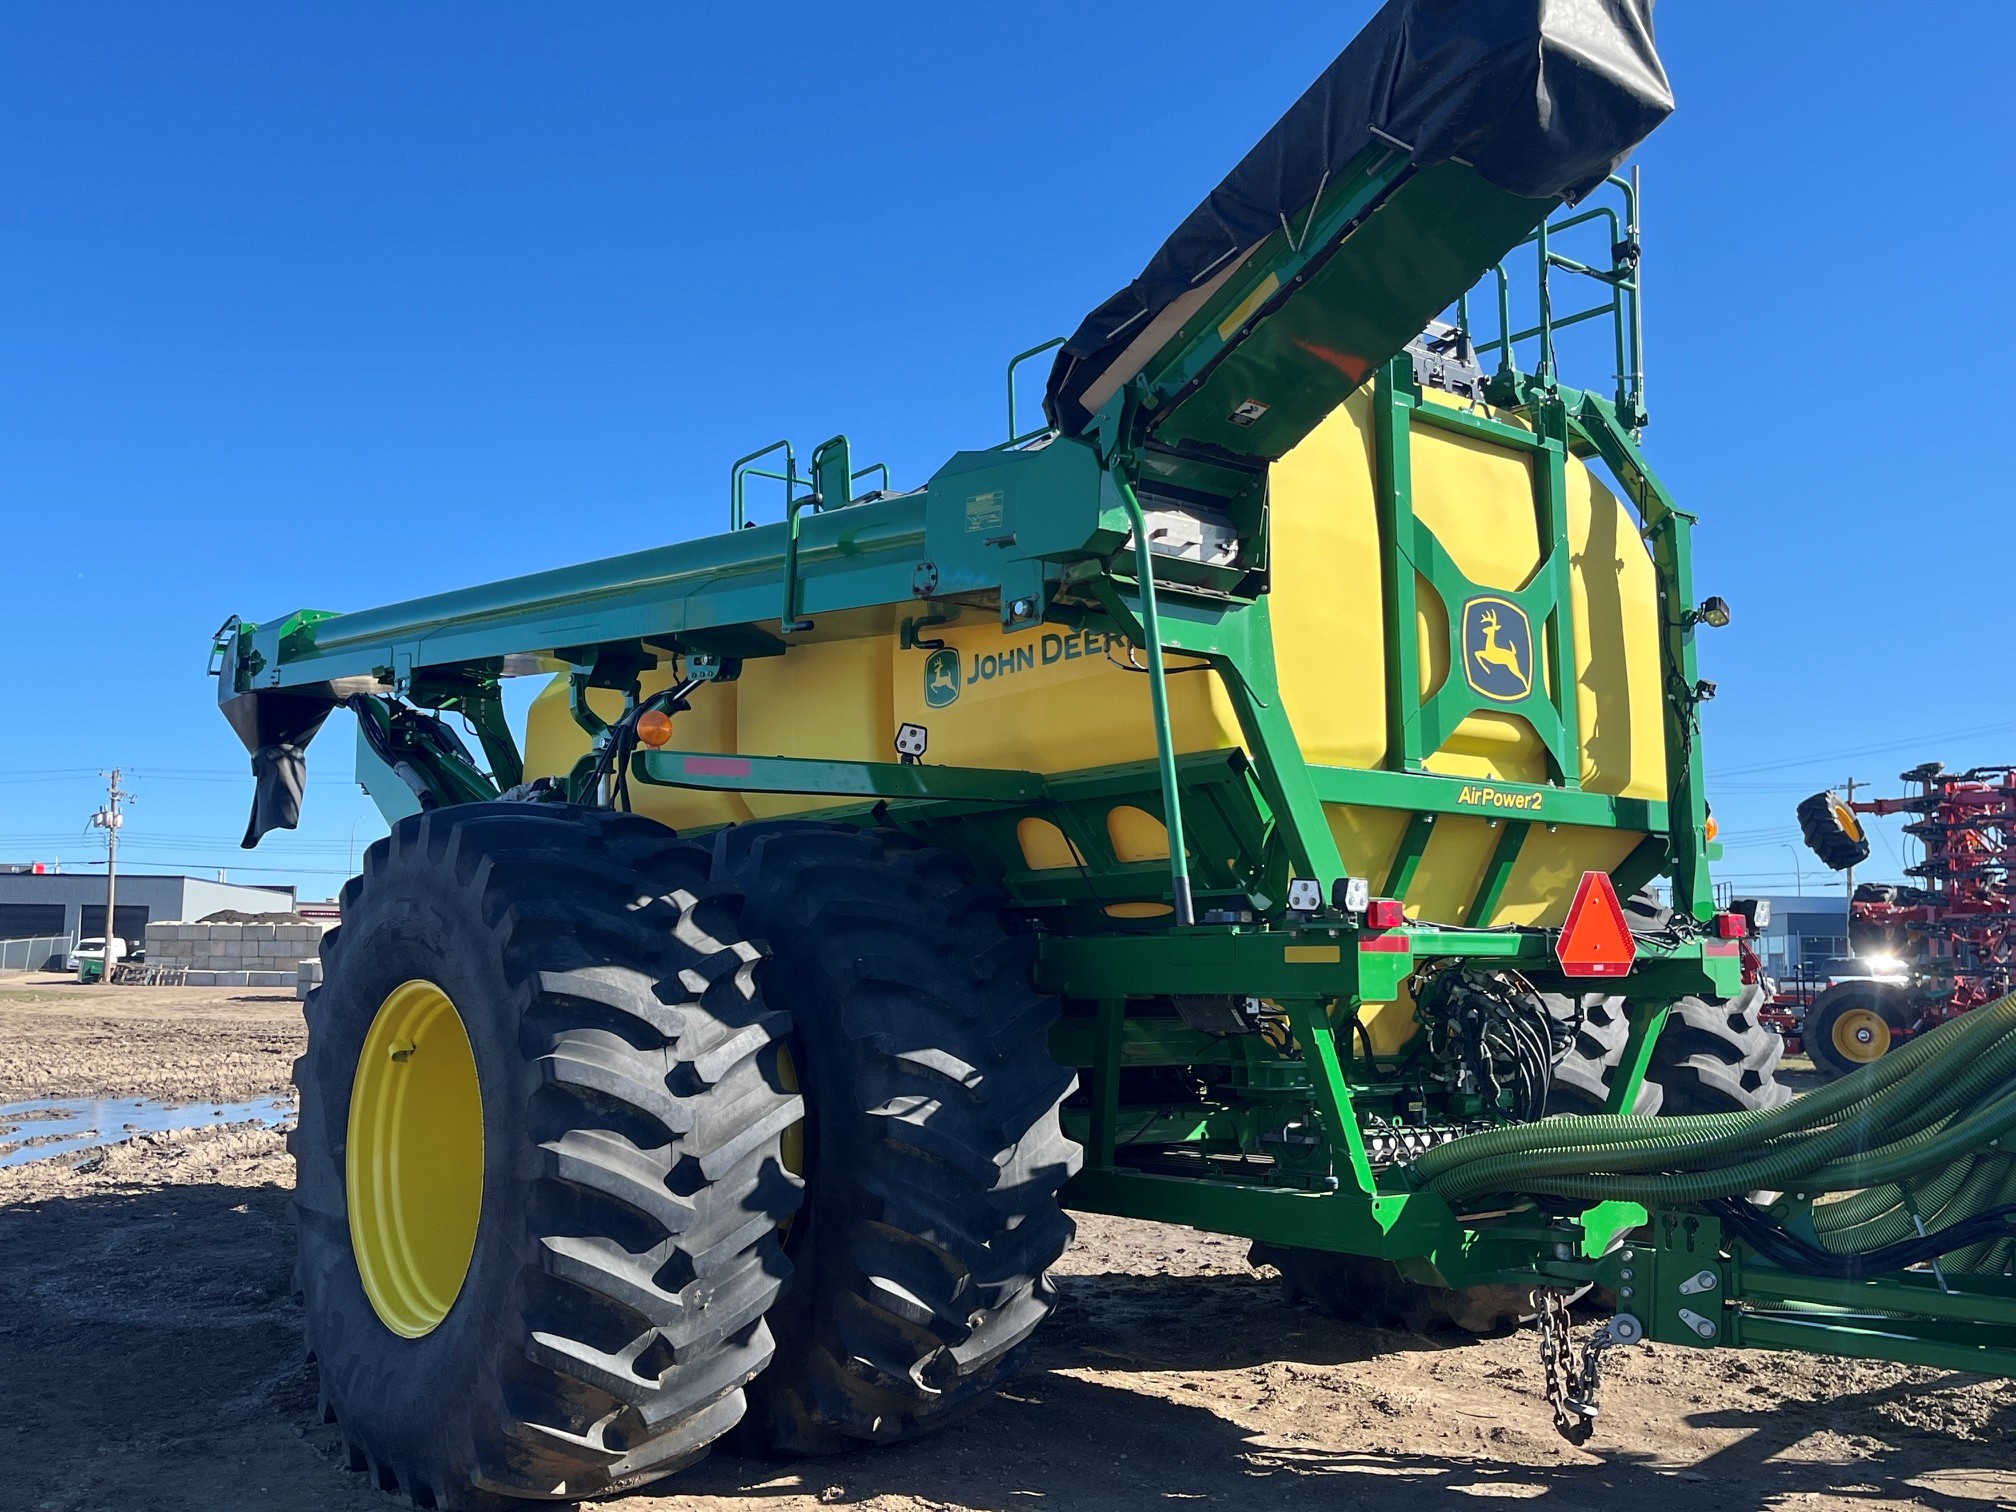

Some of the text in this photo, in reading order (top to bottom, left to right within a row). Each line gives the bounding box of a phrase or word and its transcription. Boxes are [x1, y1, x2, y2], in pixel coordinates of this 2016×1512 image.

[967, 630, 1126, 685] JOHN DEER
[1457, 785, 1543, 811] AirPower2
